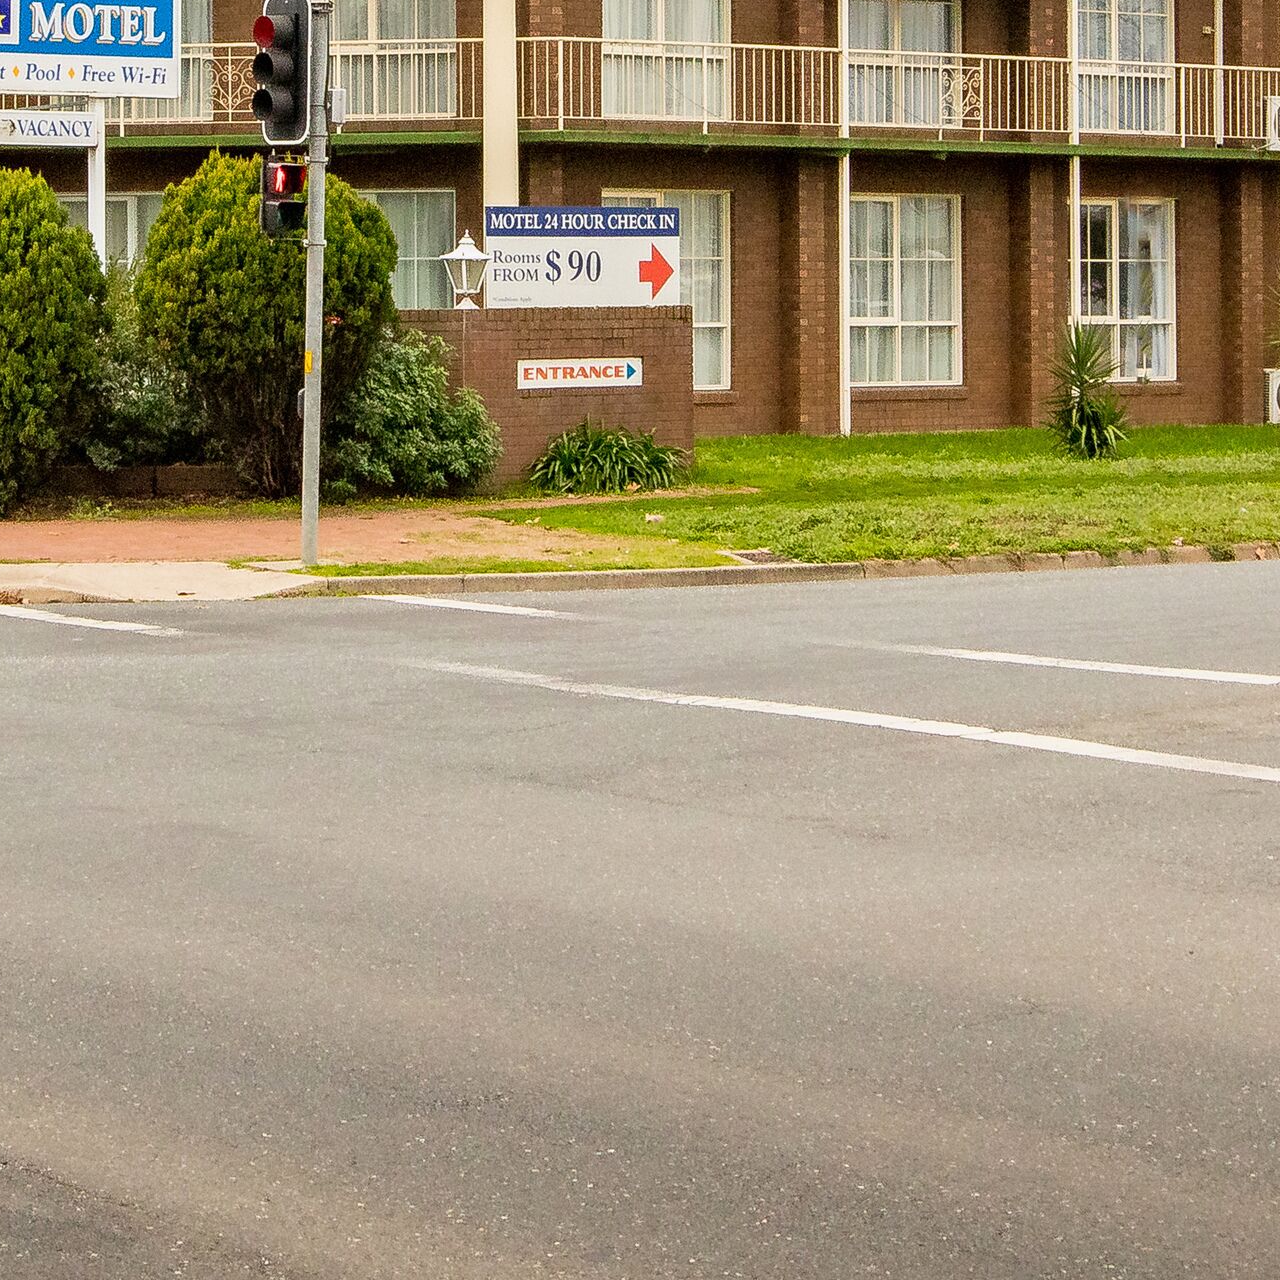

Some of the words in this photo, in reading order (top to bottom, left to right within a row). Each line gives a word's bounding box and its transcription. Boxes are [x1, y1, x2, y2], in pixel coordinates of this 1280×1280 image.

[28, 1, 166, 45] MOTEL
[25, 63, 61, 82] Pool
[82, 65, 116, 84] Free
[122, 66, 167, 86] Wi-Fi
[17, 119, 93, 138] VACANCY
[490, 213, 543, 230] MOTEL
[544, 213, 559, 230] 24
[562, 214, 606, 230] HOUR
[607, 214, 656, 230] CHECK
[658, 215, 675, 230] IN
[493, 250, 541, 264] Rooms
[493, 268, 539, 282] FROM
[523, 365, 625, 381] ENTRANCE
